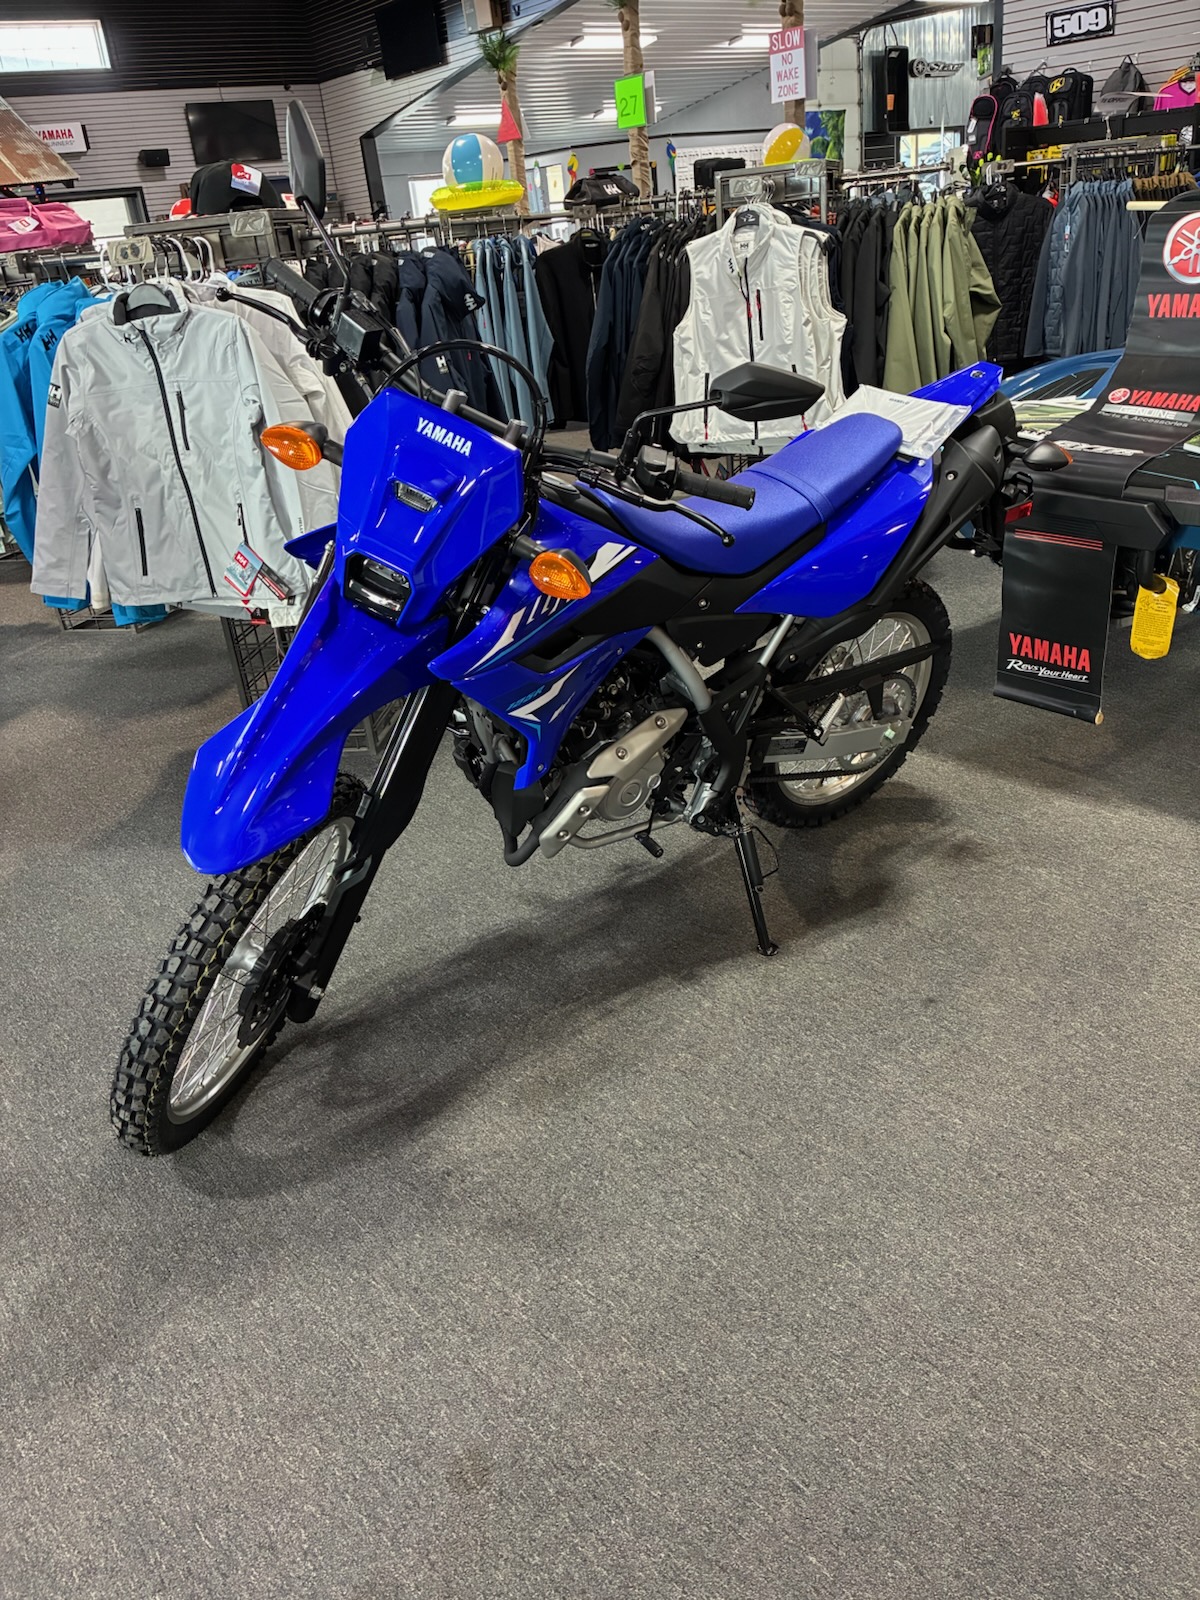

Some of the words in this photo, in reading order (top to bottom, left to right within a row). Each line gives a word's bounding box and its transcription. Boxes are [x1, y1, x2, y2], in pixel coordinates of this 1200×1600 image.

[1053, 8, 1108, 39] 509
[771, 28, 801, 51] SLOW
[781, 52, 793, 66] NO
[776, 66, 800, 82] WAKE
[777, 82, 799, 98] ZONE
[619, 94, 638, 118] 27
[602, 184, 622, 195] HH
[1147, 293, 1200, 319] YAMA
[14, 323, 34, 343] HH
[41, 328, 58, 352] HH
[1128, 389, 1200, 412] YAMAHA
[1097, 410, 1120, 419] Parts
[1131, 415, 1189, 428] Accessories
[1119, 405, 1177, 420] GENUINE
[416, 416, 473, 457] YAMAHA
[1009, 632, 1091, 673] YAMAHA
[1006, 658, 1038, 673] Revs
[1038, 666, 1061, 679] Your
[1061, 670, 1090, 683] Heart
